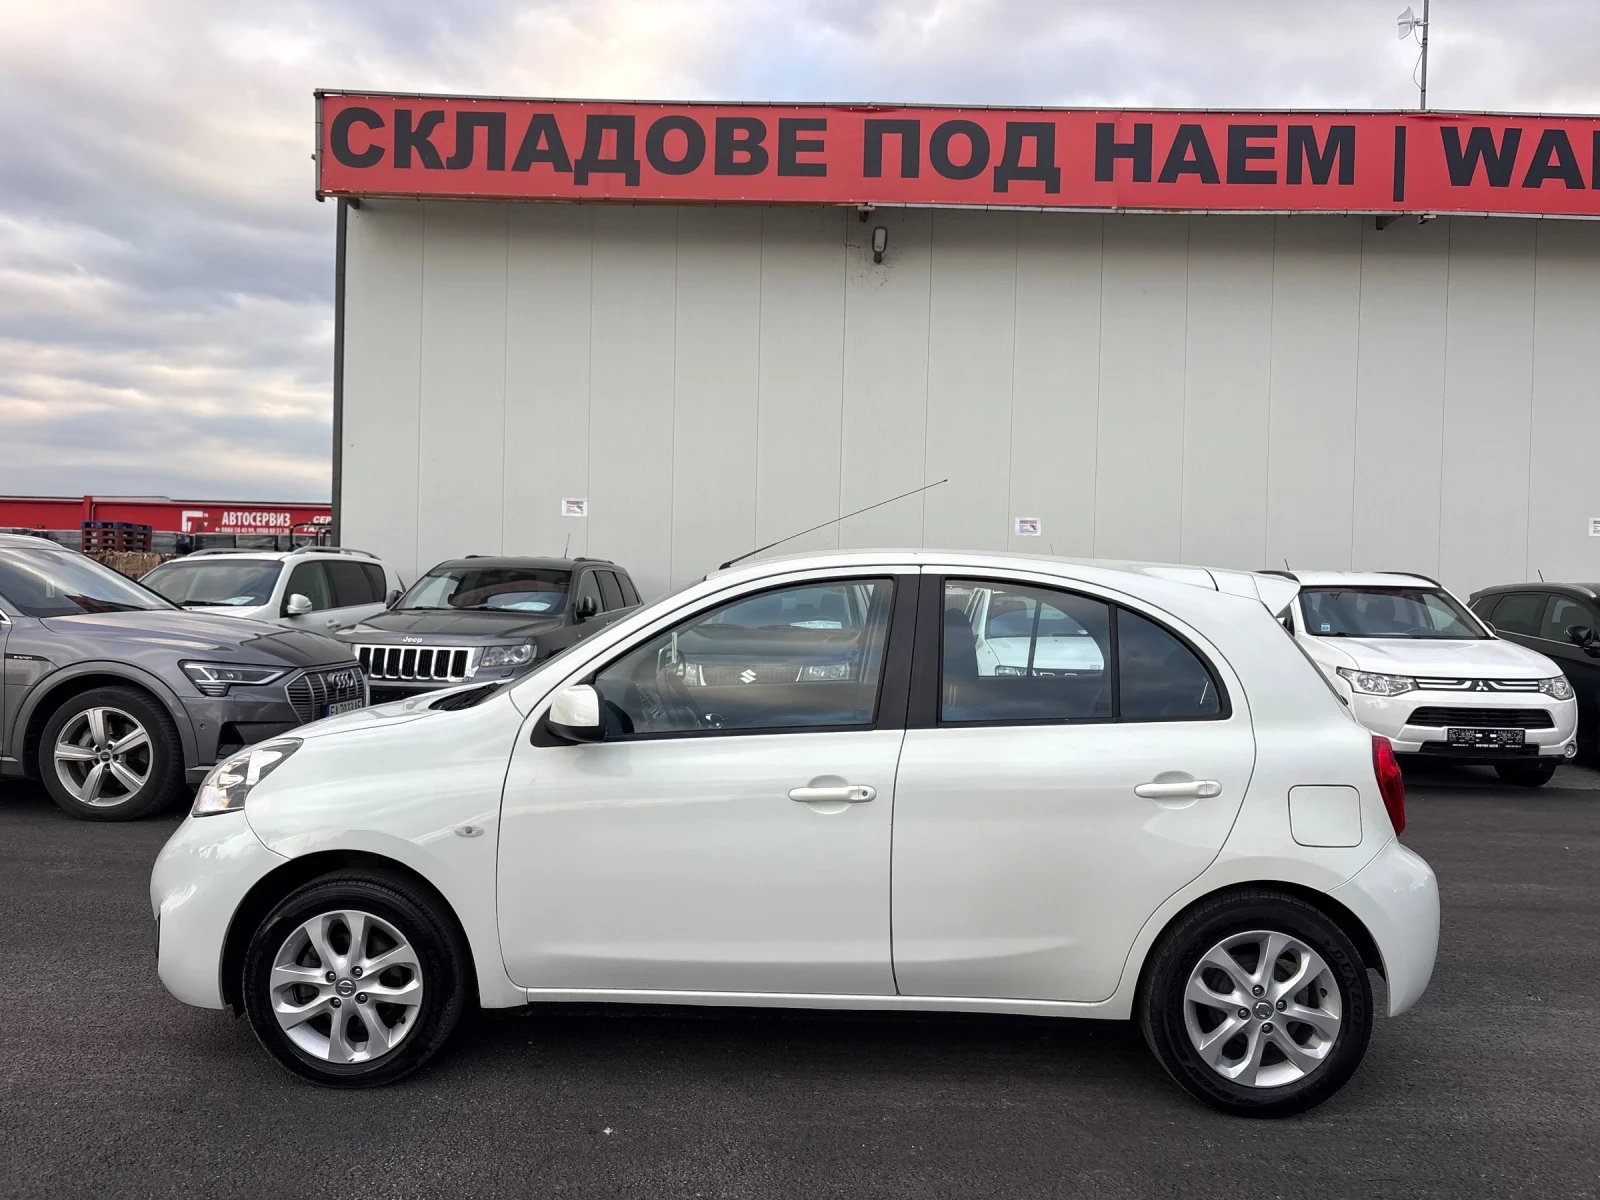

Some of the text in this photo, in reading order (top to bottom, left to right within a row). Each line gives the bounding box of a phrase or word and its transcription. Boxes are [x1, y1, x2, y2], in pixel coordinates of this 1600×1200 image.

[330, 106, 828, 187] СКЛАДОВЕ
[863, 119, 1061, 194] ПОД
[1094, 121, 1356, 186] НАЕМ
[221, 511, 291, 527] АВТОСЕРВИЗ
[402, 636, 423, 644] Jeep
[1330, 947, 1366, 1035] DUNLOP
